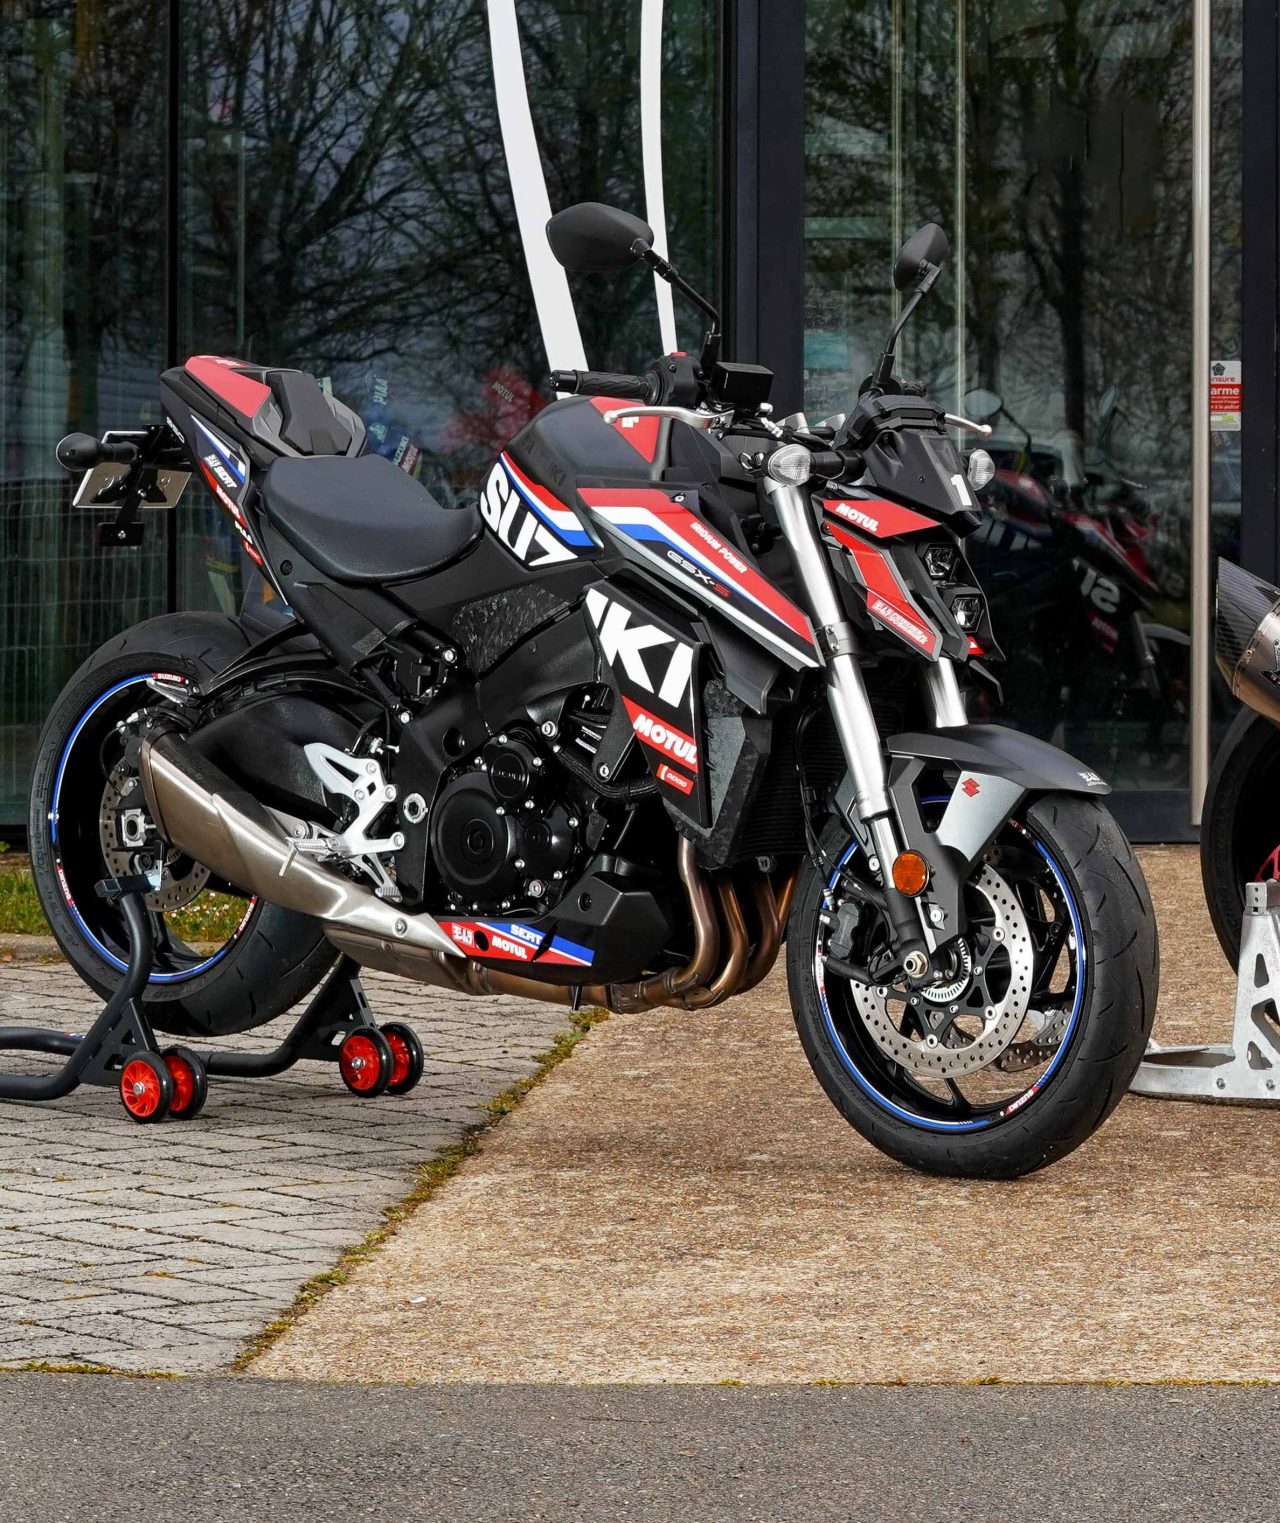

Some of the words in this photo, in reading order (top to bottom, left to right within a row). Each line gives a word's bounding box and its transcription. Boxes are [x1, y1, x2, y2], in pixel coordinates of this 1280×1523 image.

[491, 381, 515, 402] MOTUL
[1210, 388, 1240, 396] arme
[951, 473, 973, 506] 1
[835, 503, 880, 532] MOTUL
[690, 522, 721, 554] IRIDIUM
[718, 545, 748, 574] POWER
[666, 550, 730, 598] GSX-S
[633, 713, 698, 765] MOTUL
[666, 772, 687, 788] DENSO
[492, 935, 528, 959] MOTUL
[511, 924, 543, 945] SERT
